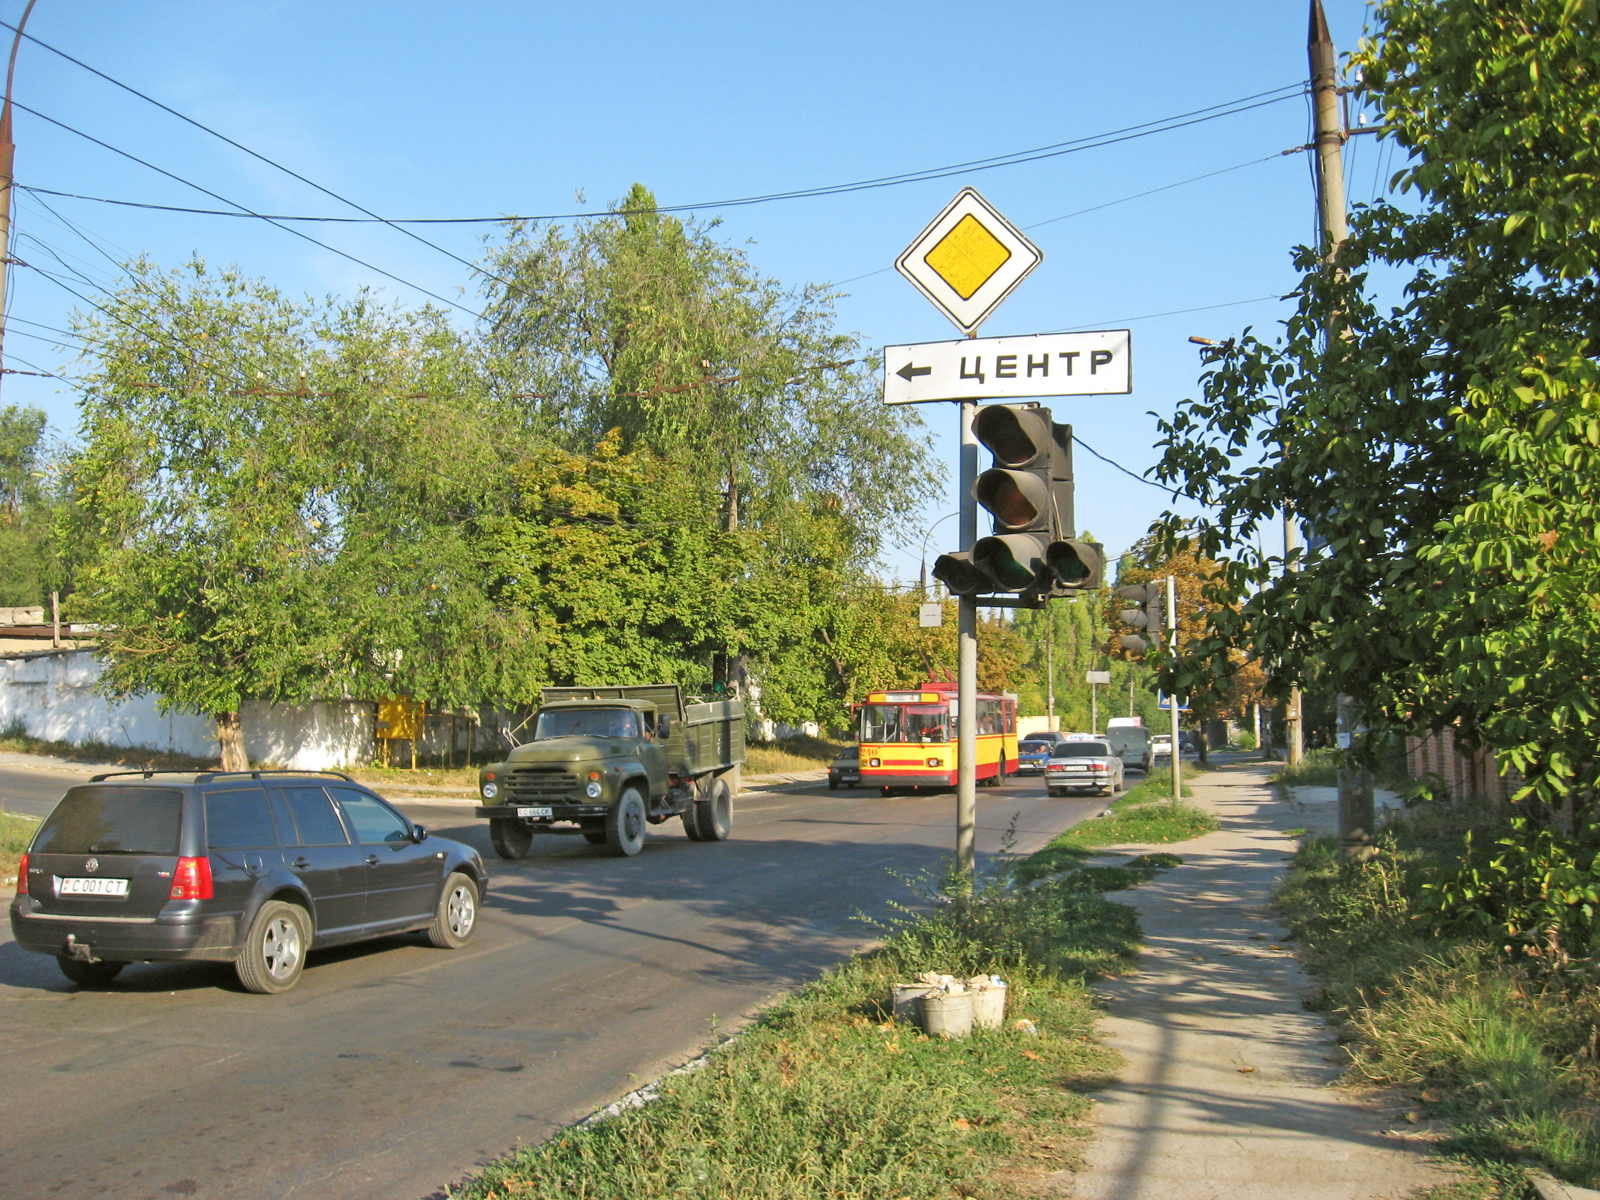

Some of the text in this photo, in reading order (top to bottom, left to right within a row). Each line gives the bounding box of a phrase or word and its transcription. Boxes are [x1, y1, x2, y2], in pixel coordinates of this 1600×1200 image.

[960, 350, 1113, 384] ЦЕНТР
[861, 748, 878, 757] 240
[72, 880, 123, 893] C 001 CT
